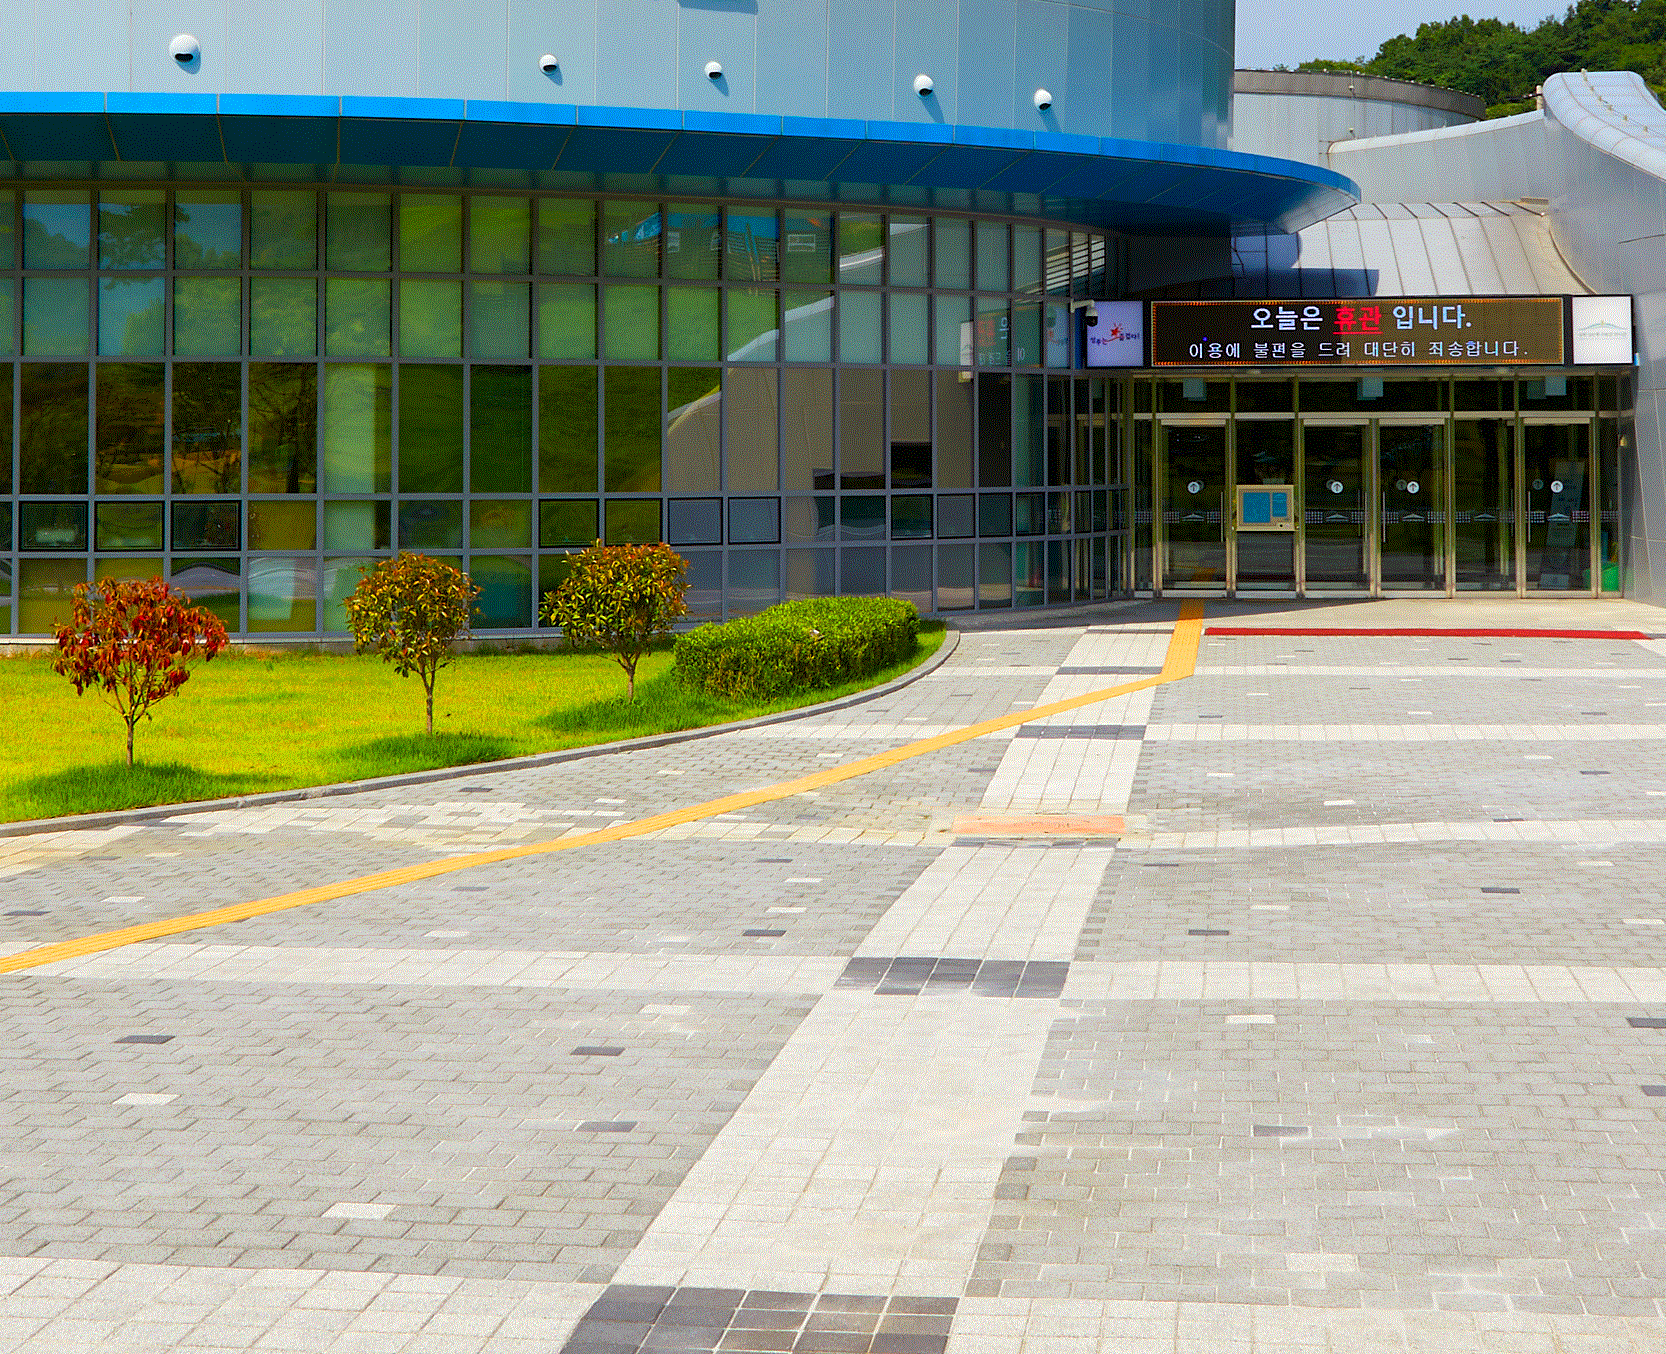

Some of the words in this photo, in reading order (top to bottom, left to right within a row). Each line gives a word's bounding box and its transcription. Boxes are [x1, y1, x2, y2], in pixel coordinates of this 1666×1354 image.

[1250, 305, 1324, 331] 오늘은
[1333, 305, 1383, 335] 휴관
[1392, 304, 1472, 330] 입니다.
[1189, 342, 1240, 359] 이용에
[1253, 342, 1306, 359] 불편을
[1318, 342, 1351, 358] 드려
[1364, 341, 1415, 358] 대단히
[1429, 340, 1529, 357] 죄송합니다.
